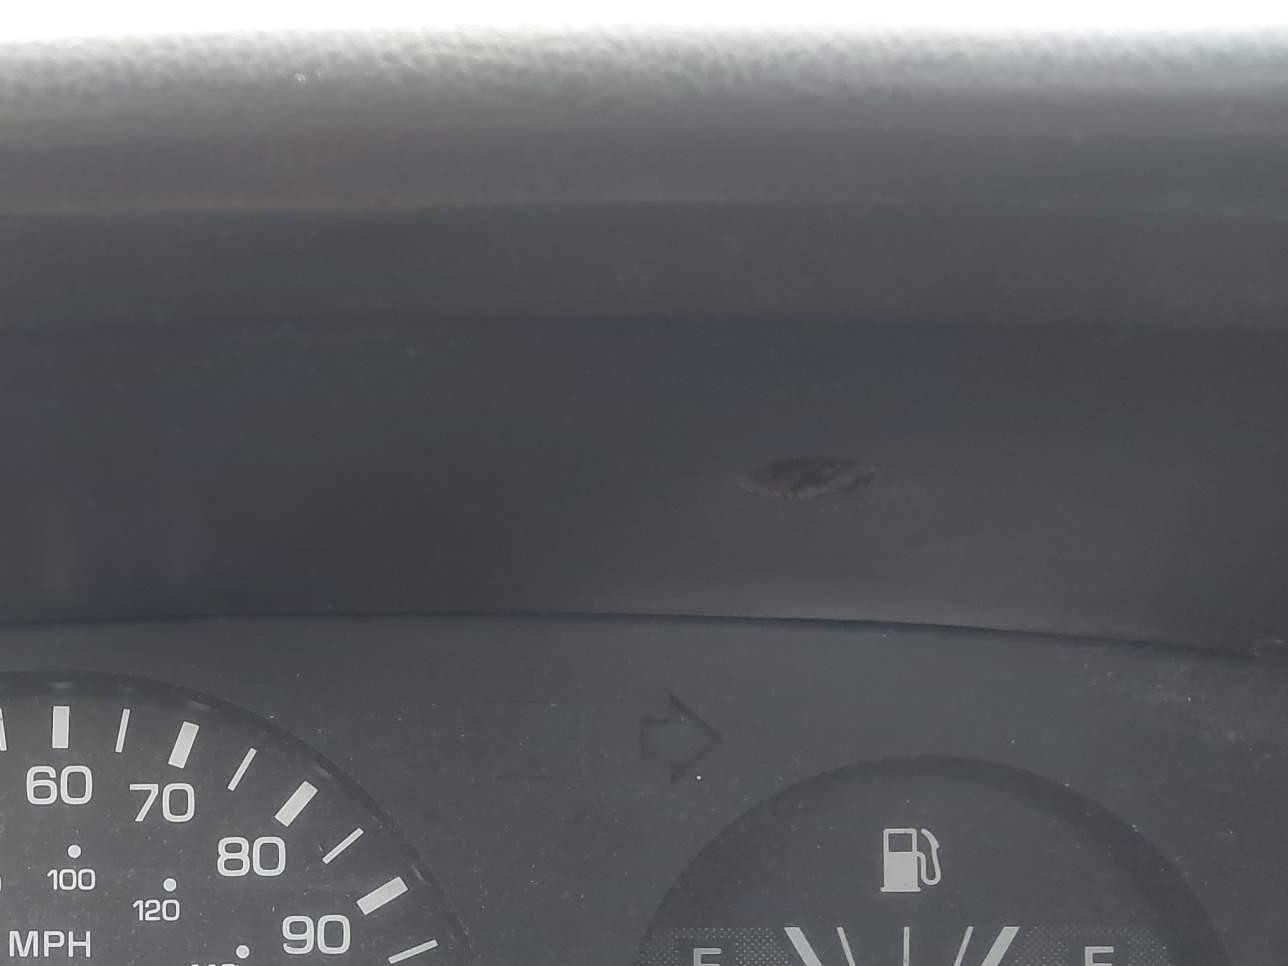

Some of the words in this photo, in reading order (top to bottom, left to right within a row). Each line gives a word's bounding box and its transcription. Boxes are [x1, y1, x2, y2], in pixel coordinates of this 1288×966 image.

[25, 765, 93, 805] 60
[129, 783, 196, 823] 70
[217, 836, 286, 876] 80
[47, 868, 96, 891] 100
[132, 899, 180, 922] 120
[9, 931, 91, 958] MPH
[281, 915, 350, 955] 90
